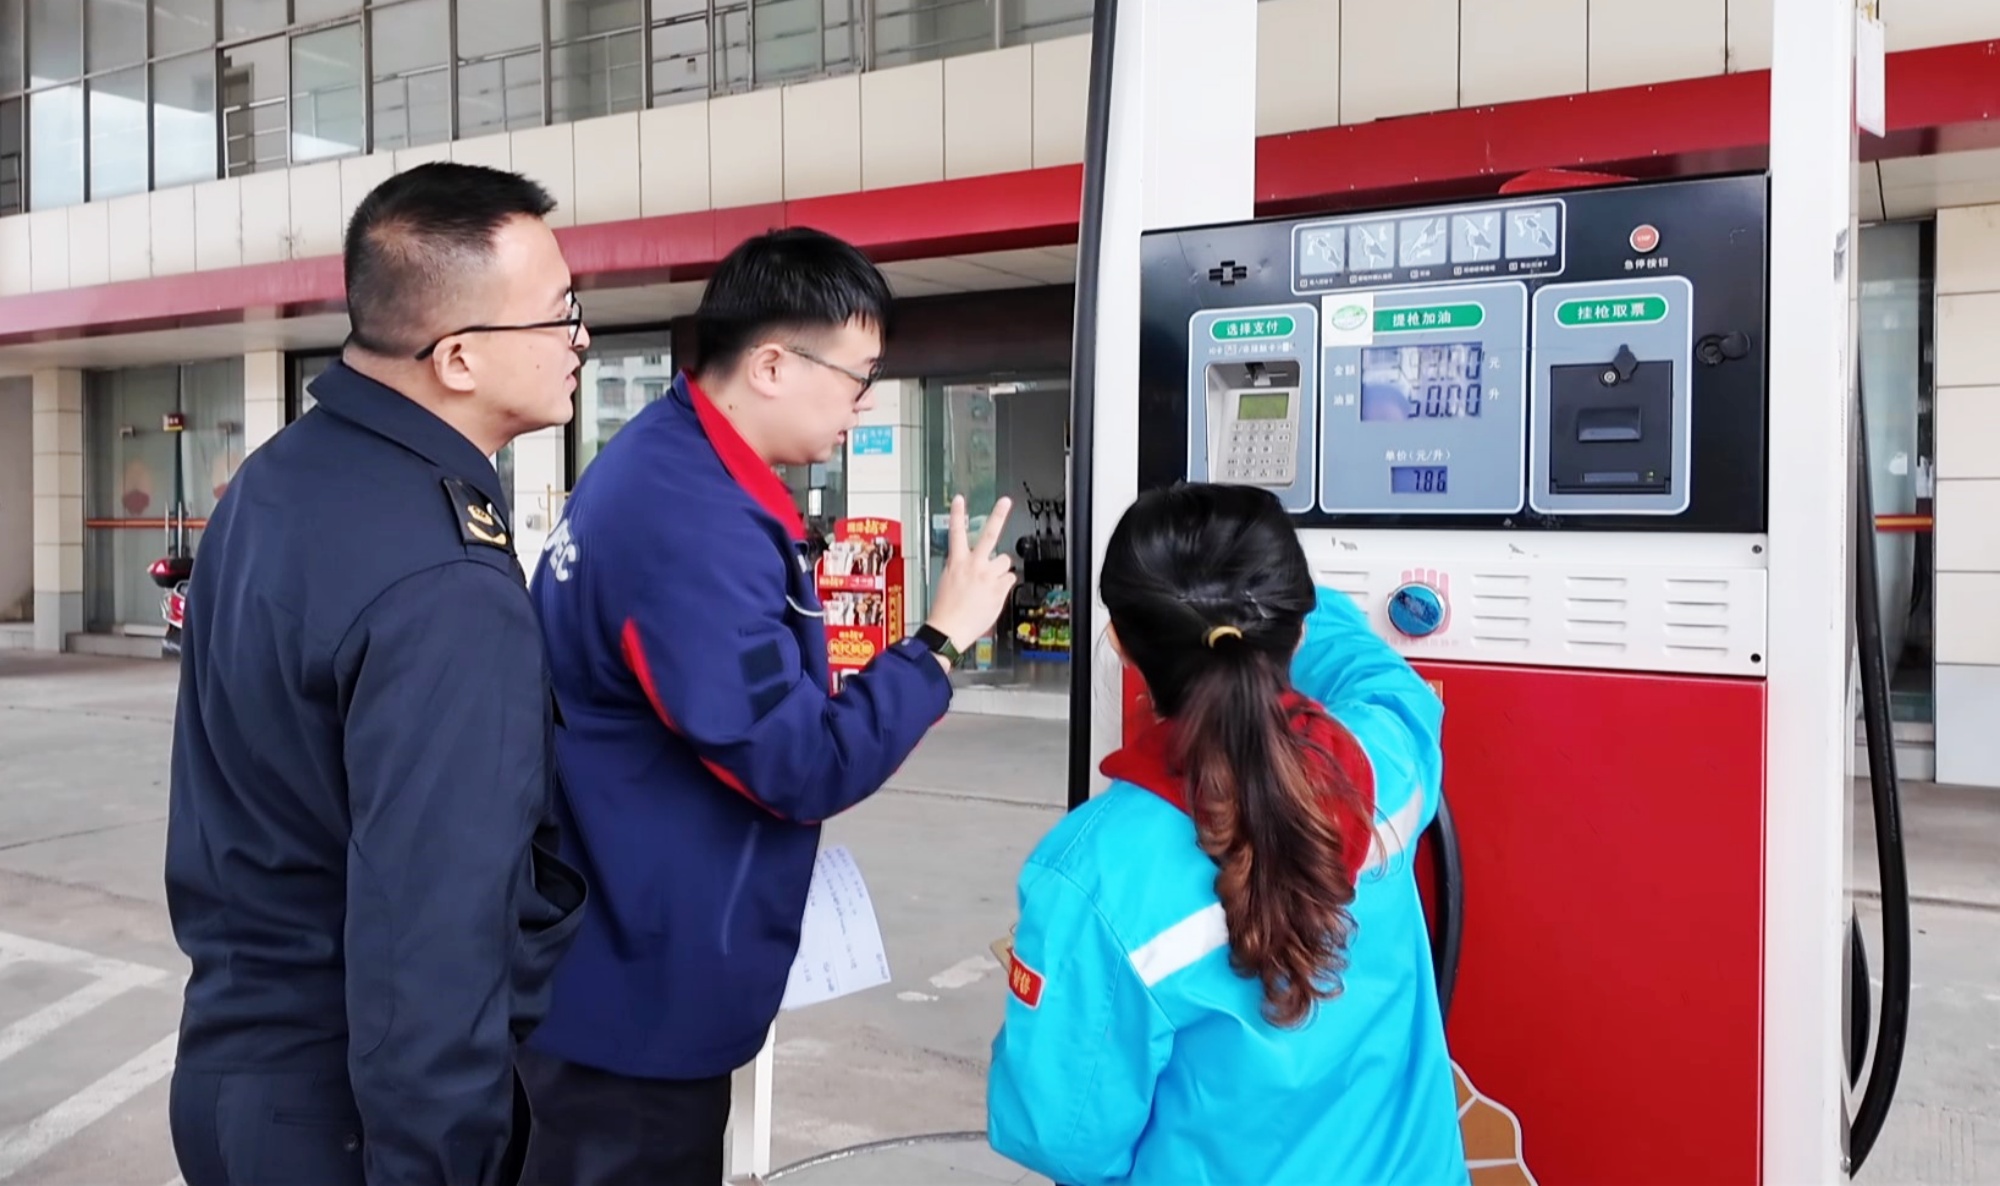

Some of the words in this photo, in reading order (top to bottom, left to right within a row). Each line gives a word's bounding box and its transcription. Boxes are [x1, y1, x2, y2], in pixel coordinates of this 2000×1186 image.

[1392, 310, 1452, 328] 提枪加油
[1577, 302, 1646, 320] 挂枪取票
[1226, 320, 1279, 336] 选择支付
[1488, 356, 1501, 370] 元
[1407, 383, 1482, 419] 50.00
